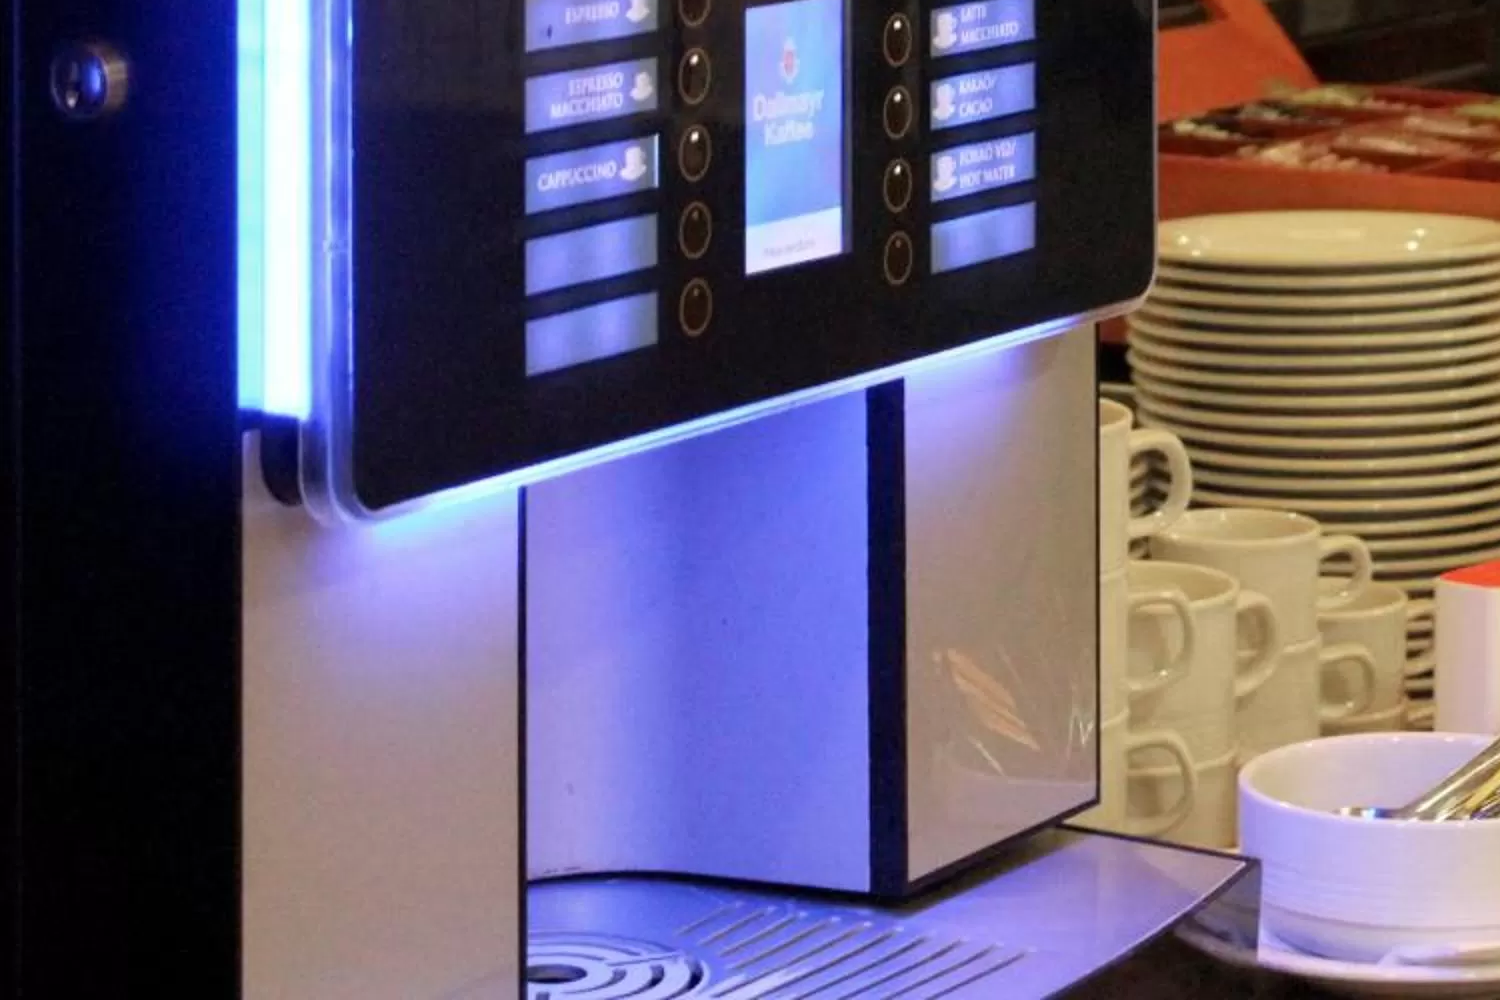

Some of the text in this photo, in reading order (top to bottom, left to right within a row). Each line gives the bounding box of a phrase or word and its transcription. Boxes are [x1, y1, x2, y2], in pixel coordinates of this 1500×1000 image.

[568, 71, 624, 97] ESPRESSO
[549, 92, 623, 119] MACCHIATO
[753, 89, 825, 121] Dallmayr
[537, 161, 617, 192] CAPPUCCINO
